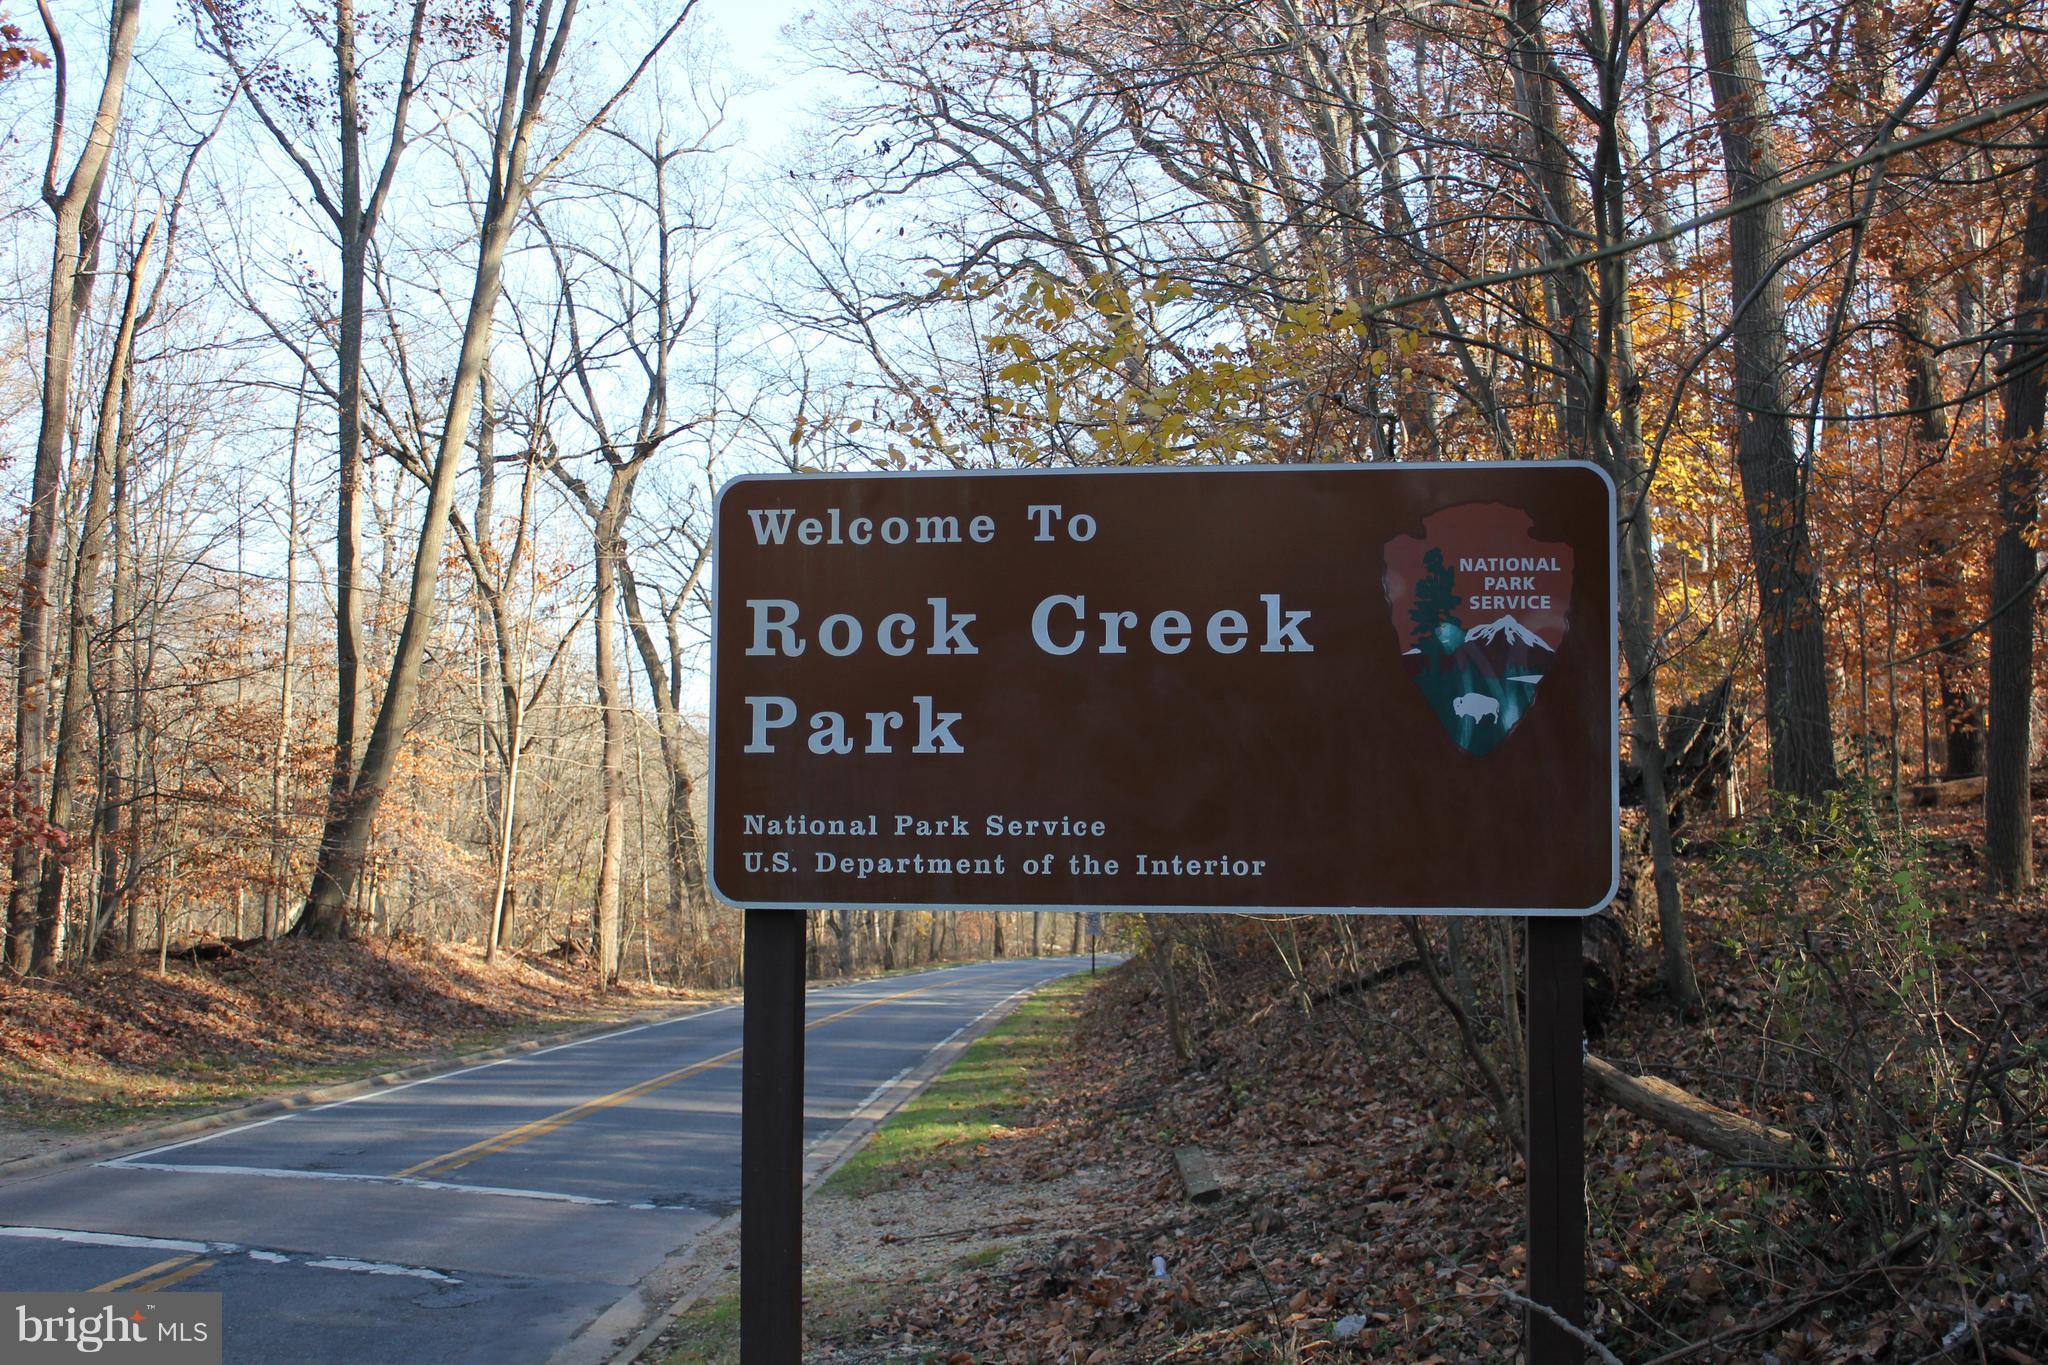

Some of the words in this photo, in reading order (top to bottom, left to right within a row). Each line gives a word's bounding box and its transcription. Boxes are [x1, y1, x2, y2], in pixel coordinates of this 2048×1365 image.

[747, 508, 995, 546] Welcome
[1027, 504, 1097, 542] To
[1459, 557, 1561, 572] NATIONAL
[1484, 576, 1536, 591] PARK
[1469, 595, 1551, 610] SERVICE
[745, 597, 979, 658] Rock
[1031, 593, 1315, 656] Creek
[743, 695, 965, 755] Park
[743, 814, 878, 836] National
[894, 815, 970, 836] Park
[986, 814, 1106, 837] Service
[742, 851, 798, 873] U.S.
[815, 852, 1005, 879] Department
[1022, 853, 1055, 875] of
[1068, 854, 1119, 876] the
[1135, 854, 1266, 877] Interior
